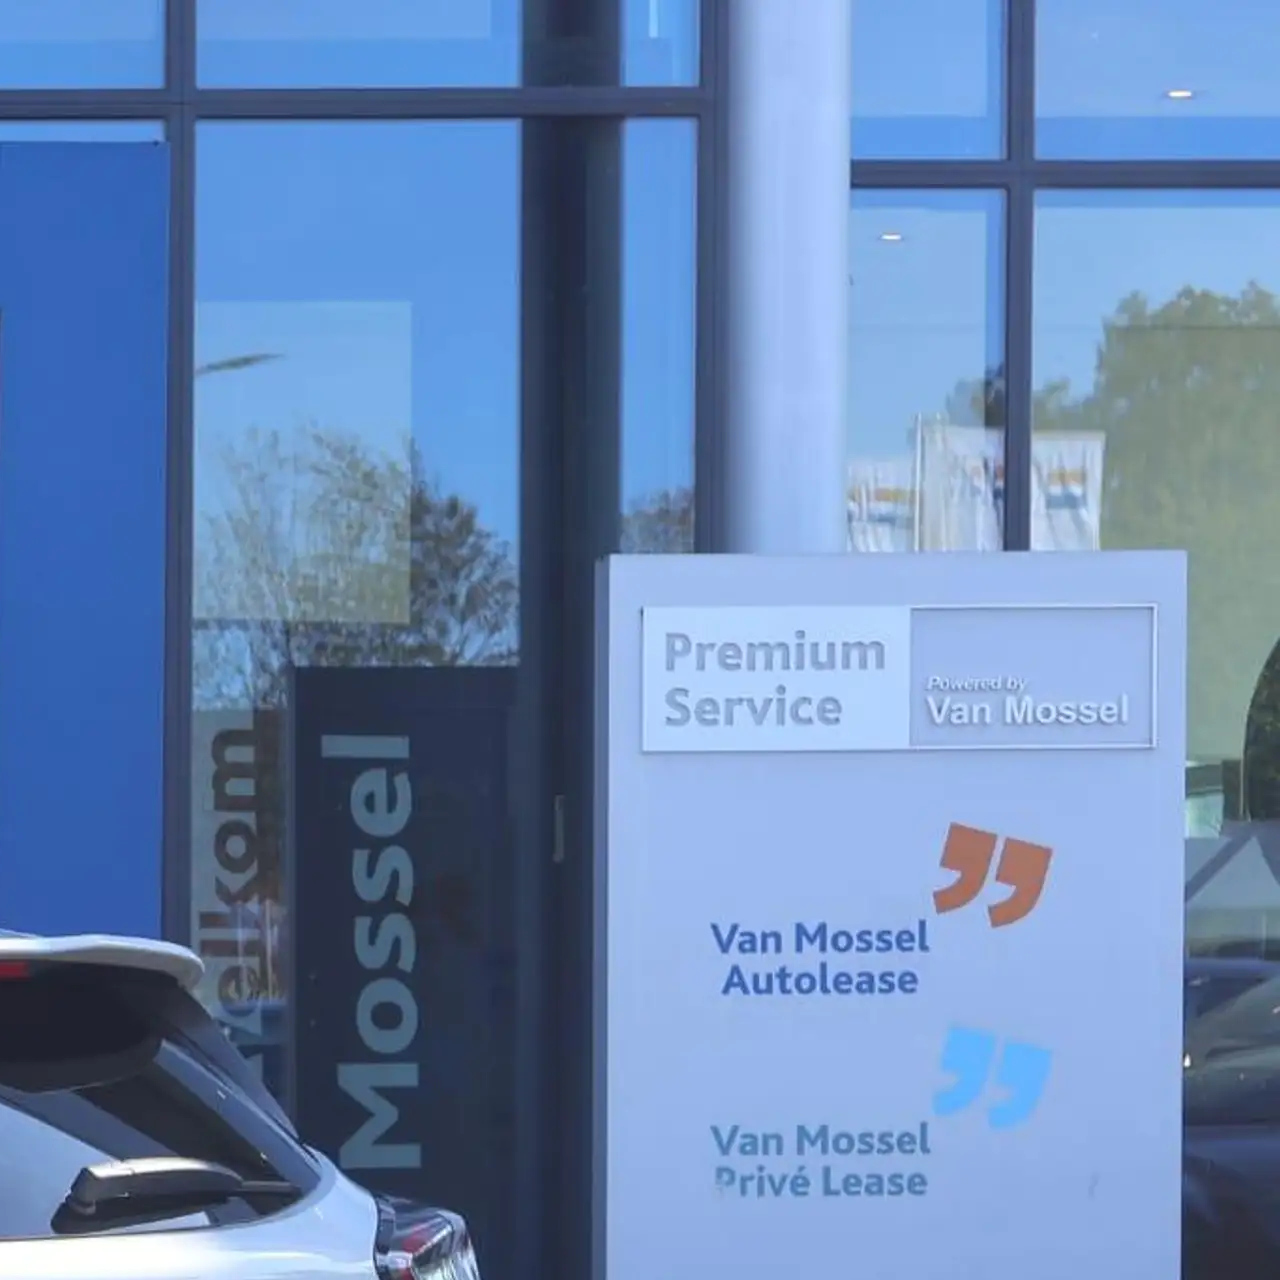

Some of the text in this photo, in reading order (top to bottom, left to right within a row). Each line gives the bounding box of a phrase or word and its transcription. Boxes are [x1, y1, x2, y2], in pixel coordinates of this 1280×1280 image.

[665, 629, 885, 672] Premium
[665, 683, 843, 727] Service
[926, 692, 1130, 725] Van Mossel
[320, 734, 422, 1170] Mossel
[710, 919, 930, 955] Van Mossel
[721, 961, 919, 996] Autolease
[709, 1121, 931, 1157] Van Mossel
[822, 1165, 928, 1197] Lease
